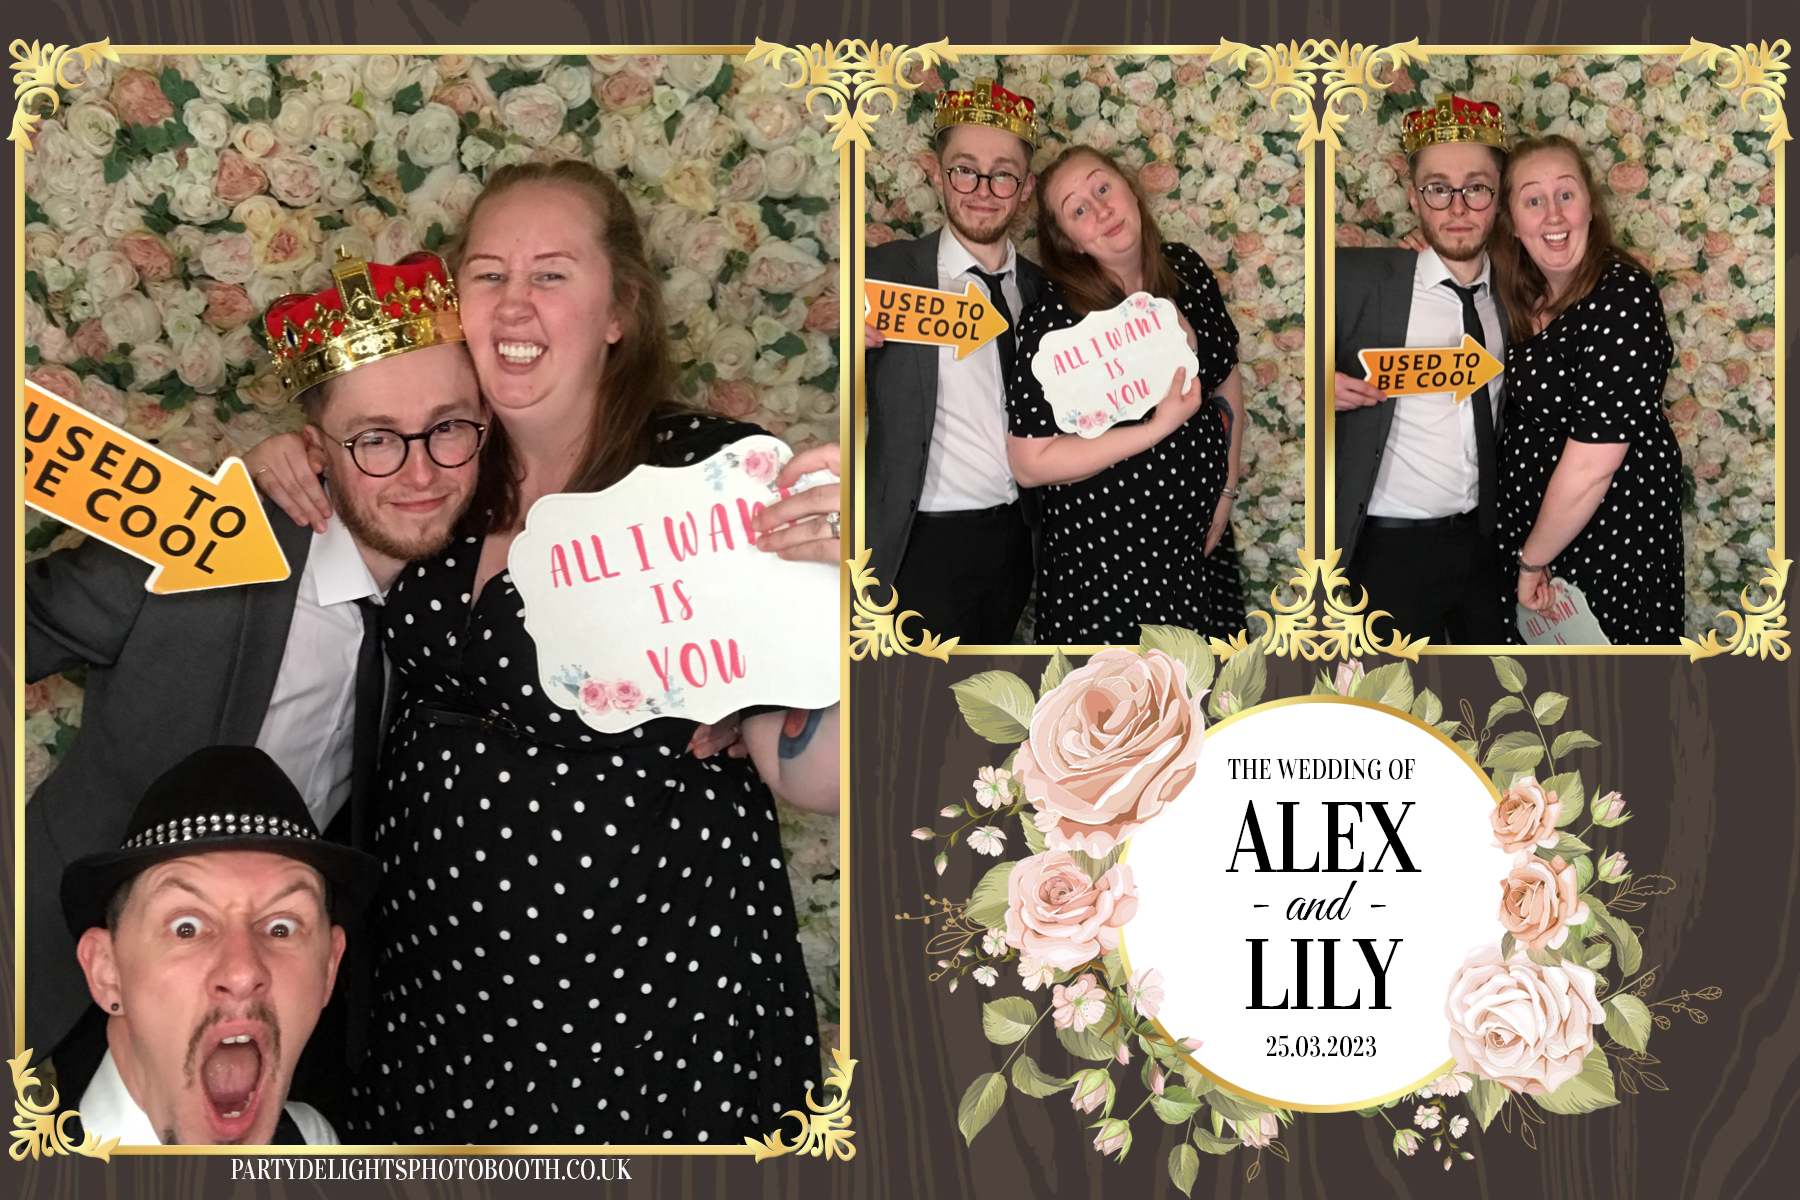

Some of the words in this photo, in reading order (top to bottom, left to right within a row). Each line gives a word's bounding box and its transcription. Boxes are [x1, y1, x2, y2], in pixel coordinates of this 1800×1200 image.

[879, 289, 945, 316] USED
[956, 300, 985, 321] TO
[876, 311, 906, 333] BE
[917, 317, 980, 341] COOL
[1053, 346, 1089, 376] ALL
[1089, 336, 1104, 359] I
[1105, 310, 1162, 351] WANT
[1103, 357, 1125, 380] IS
[1377, 373, 1406, 391] BE
[1416, 371, 1476, 388] COOL
[1379, 354, 1442, 372] USED
[1453, 353, 1480, 369] TO
[1106, 378, 1151, 410] YOU
[25, 401, 161, 495] USED
[184, 485, 246, 538] TO
[86, 488, 218, 575] COOL
[550, 534, 621, 588] ALL
[626, 523, 655, 573] I
[649, 579, 693, 624] IS
[646, 638, 746, 692] YOU
